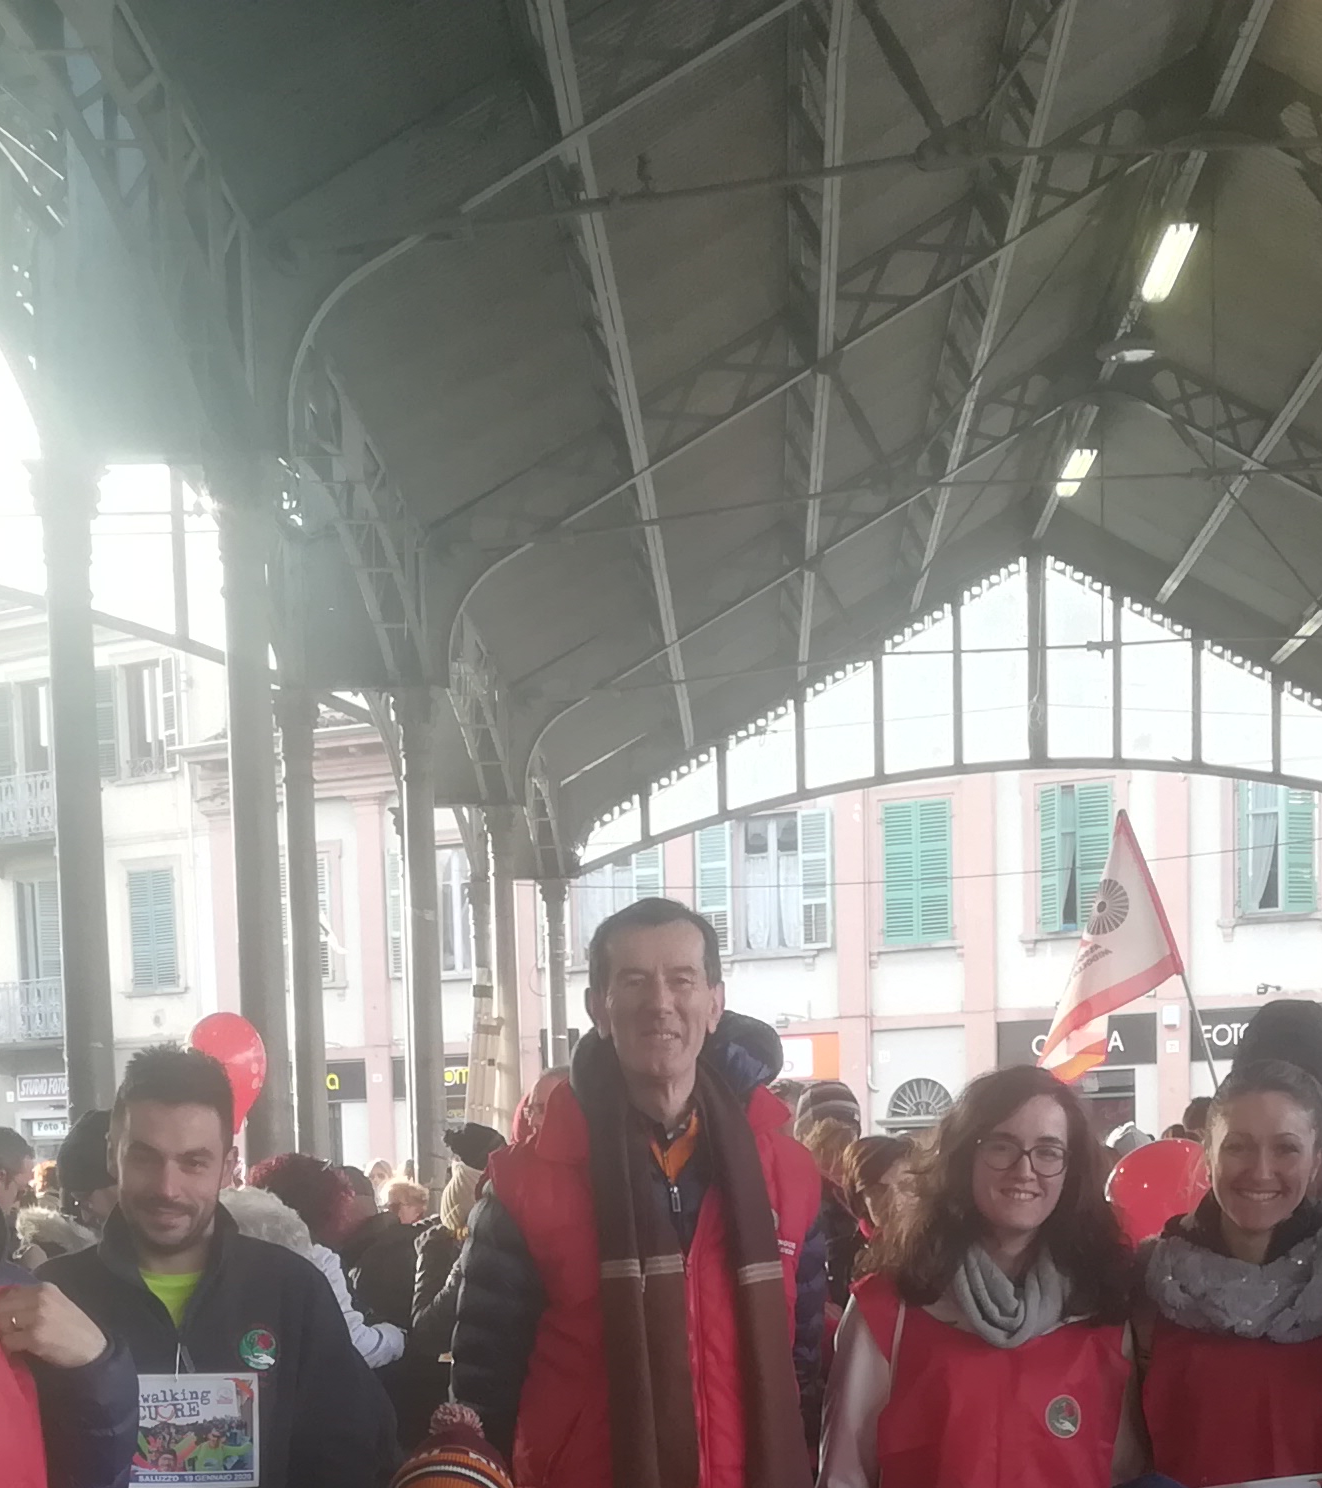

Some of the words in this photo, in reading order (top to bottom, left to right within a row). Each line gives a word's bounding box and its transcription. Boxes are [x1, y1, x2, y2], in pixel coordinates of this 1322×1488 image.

[21, 1079, 47, 1095] STUDIO
[37, 1121, 59, 1131] Foto
[140, 1389, 211, 1405] walking
[195, 1474, 232, 1482] GENNAIO
[234, 1473, 252, 1481] 2020
